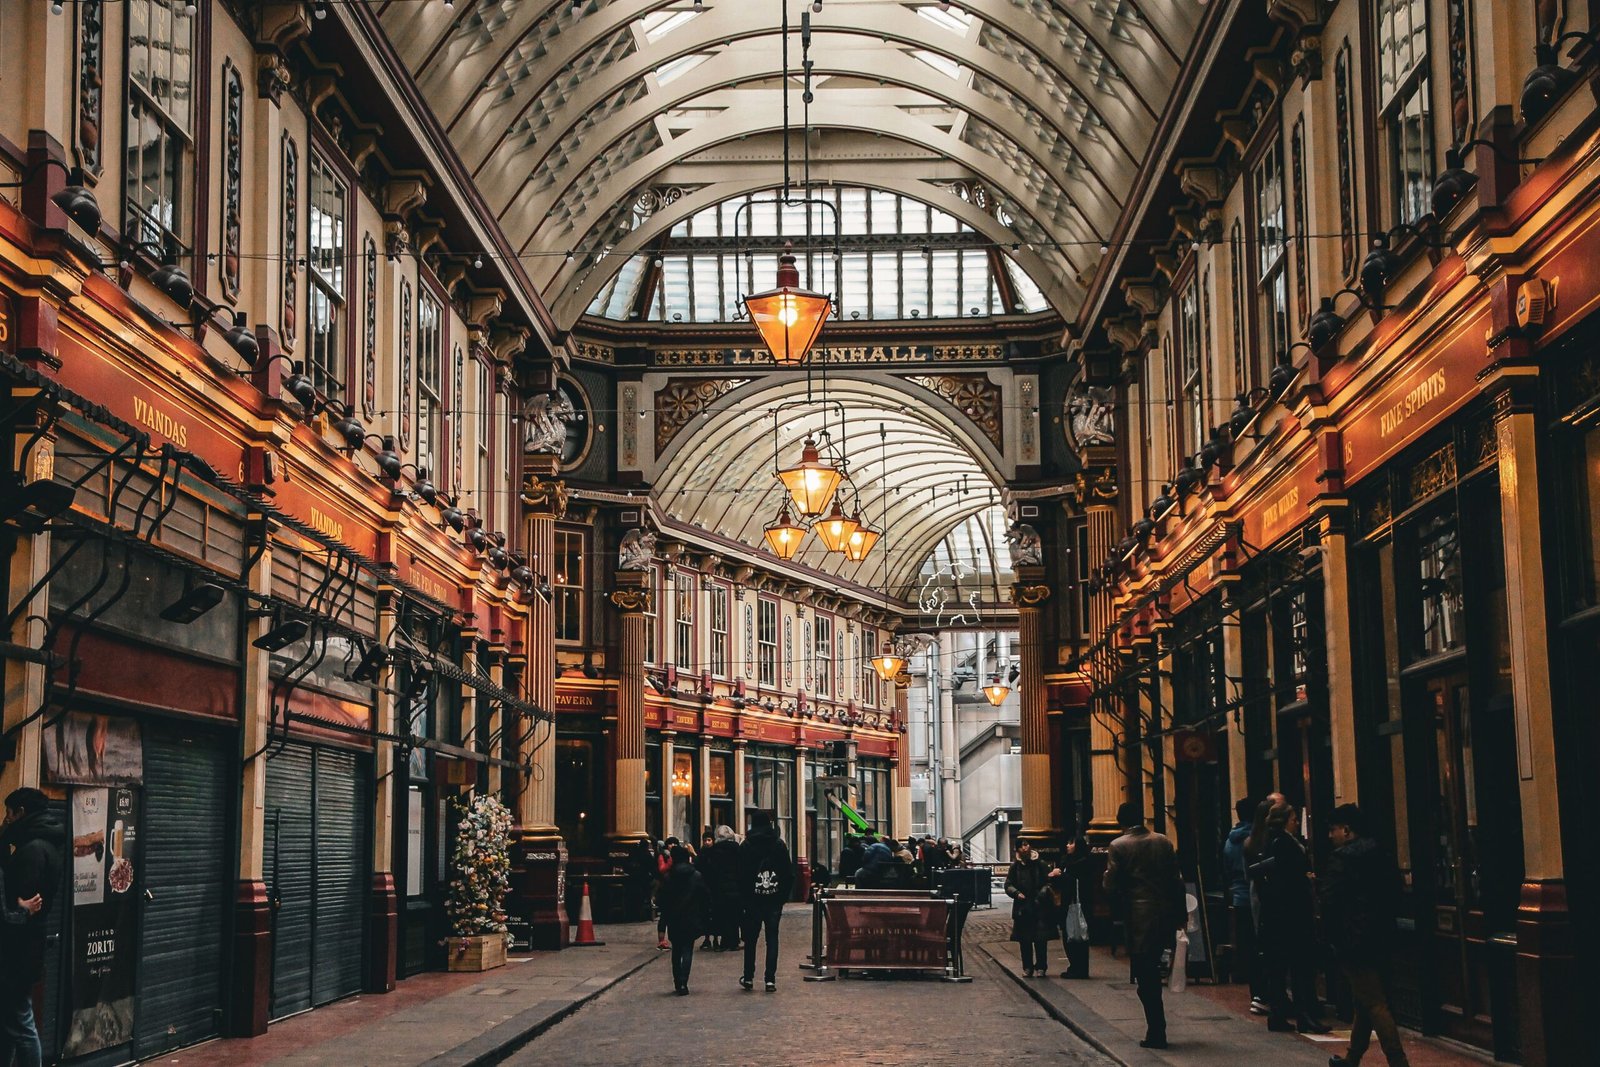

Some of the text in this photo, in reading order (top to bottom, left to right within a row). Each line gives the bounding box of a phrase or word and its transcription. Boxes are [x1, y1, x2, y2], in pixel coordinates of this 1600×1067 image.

[733, 346, 926, 364] LEENHALL
[1380, 367, 1446, 437] FINE SPIRITS
[134, 395, 187, 448] VIANDAS
[311, 506, 343, 542] VIANDAS
[554, 695, 593, 705] TAVERN
